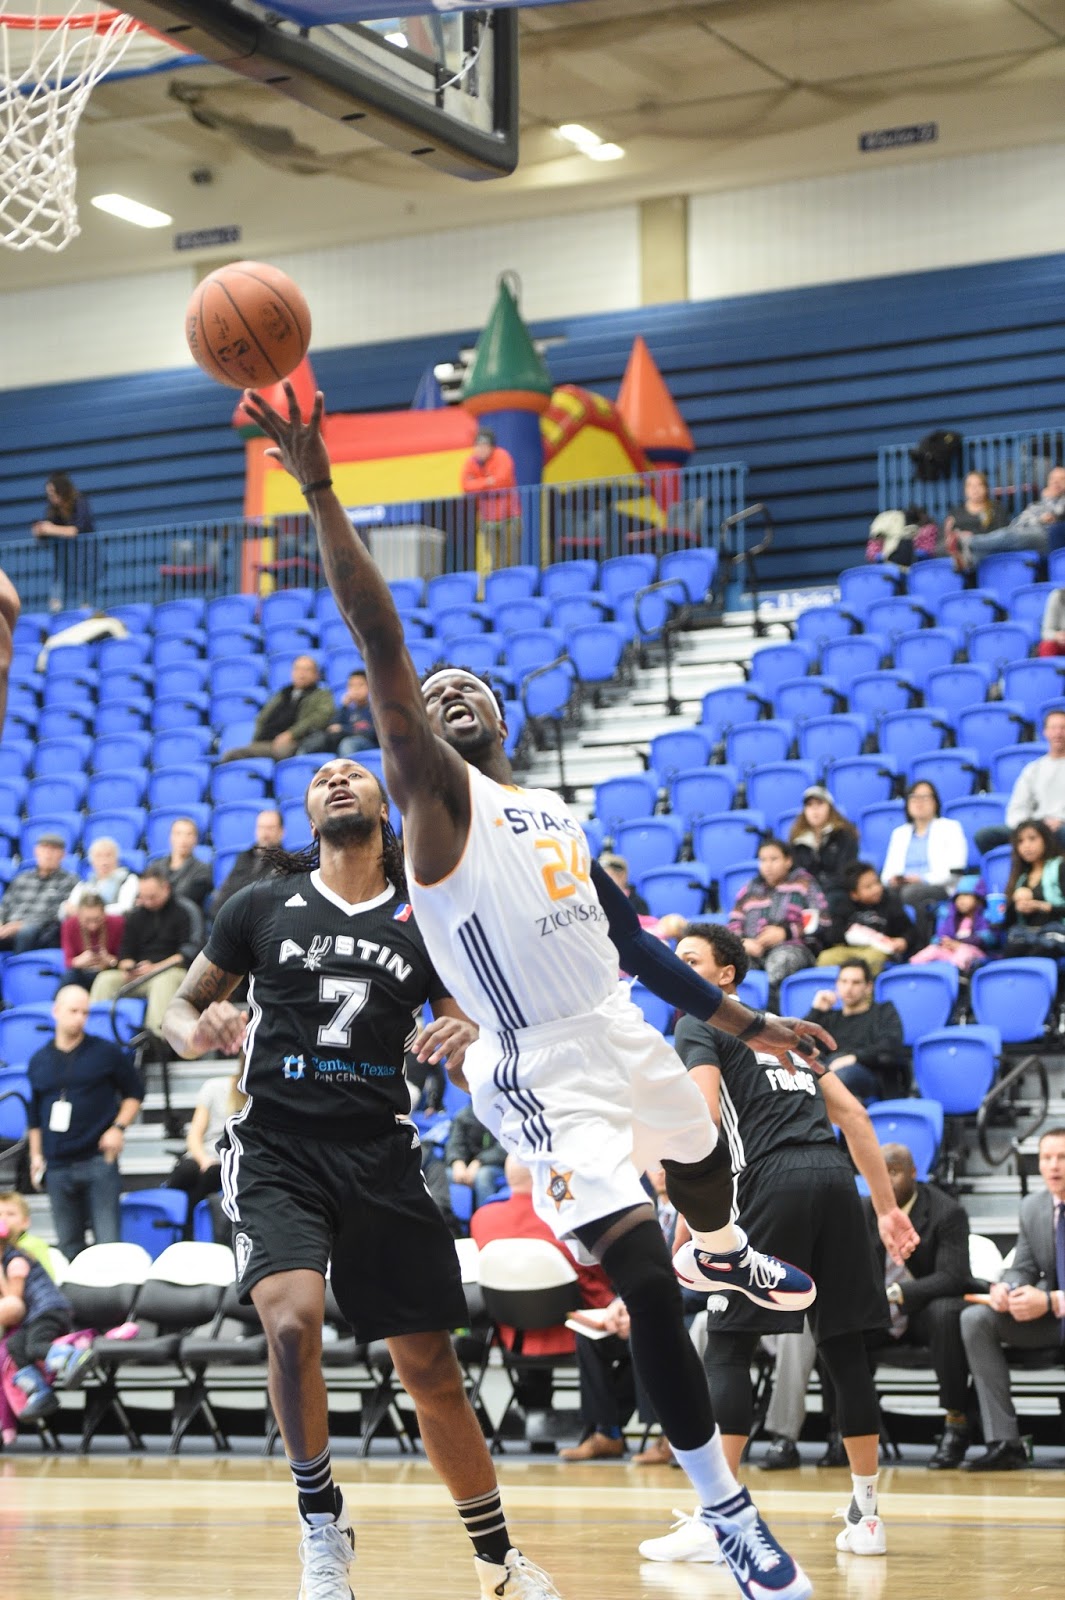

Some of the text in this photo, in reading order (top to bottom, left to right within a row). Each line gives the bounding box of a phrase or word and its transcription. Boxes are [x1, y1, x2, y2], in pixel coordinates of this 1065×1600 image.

[535, 838, 589, 902] 24
[278, 934, 413, 982] AUSTIN
[317, 975, 372, 1048] 7
[360, 1062, 397, 1077] Texas
